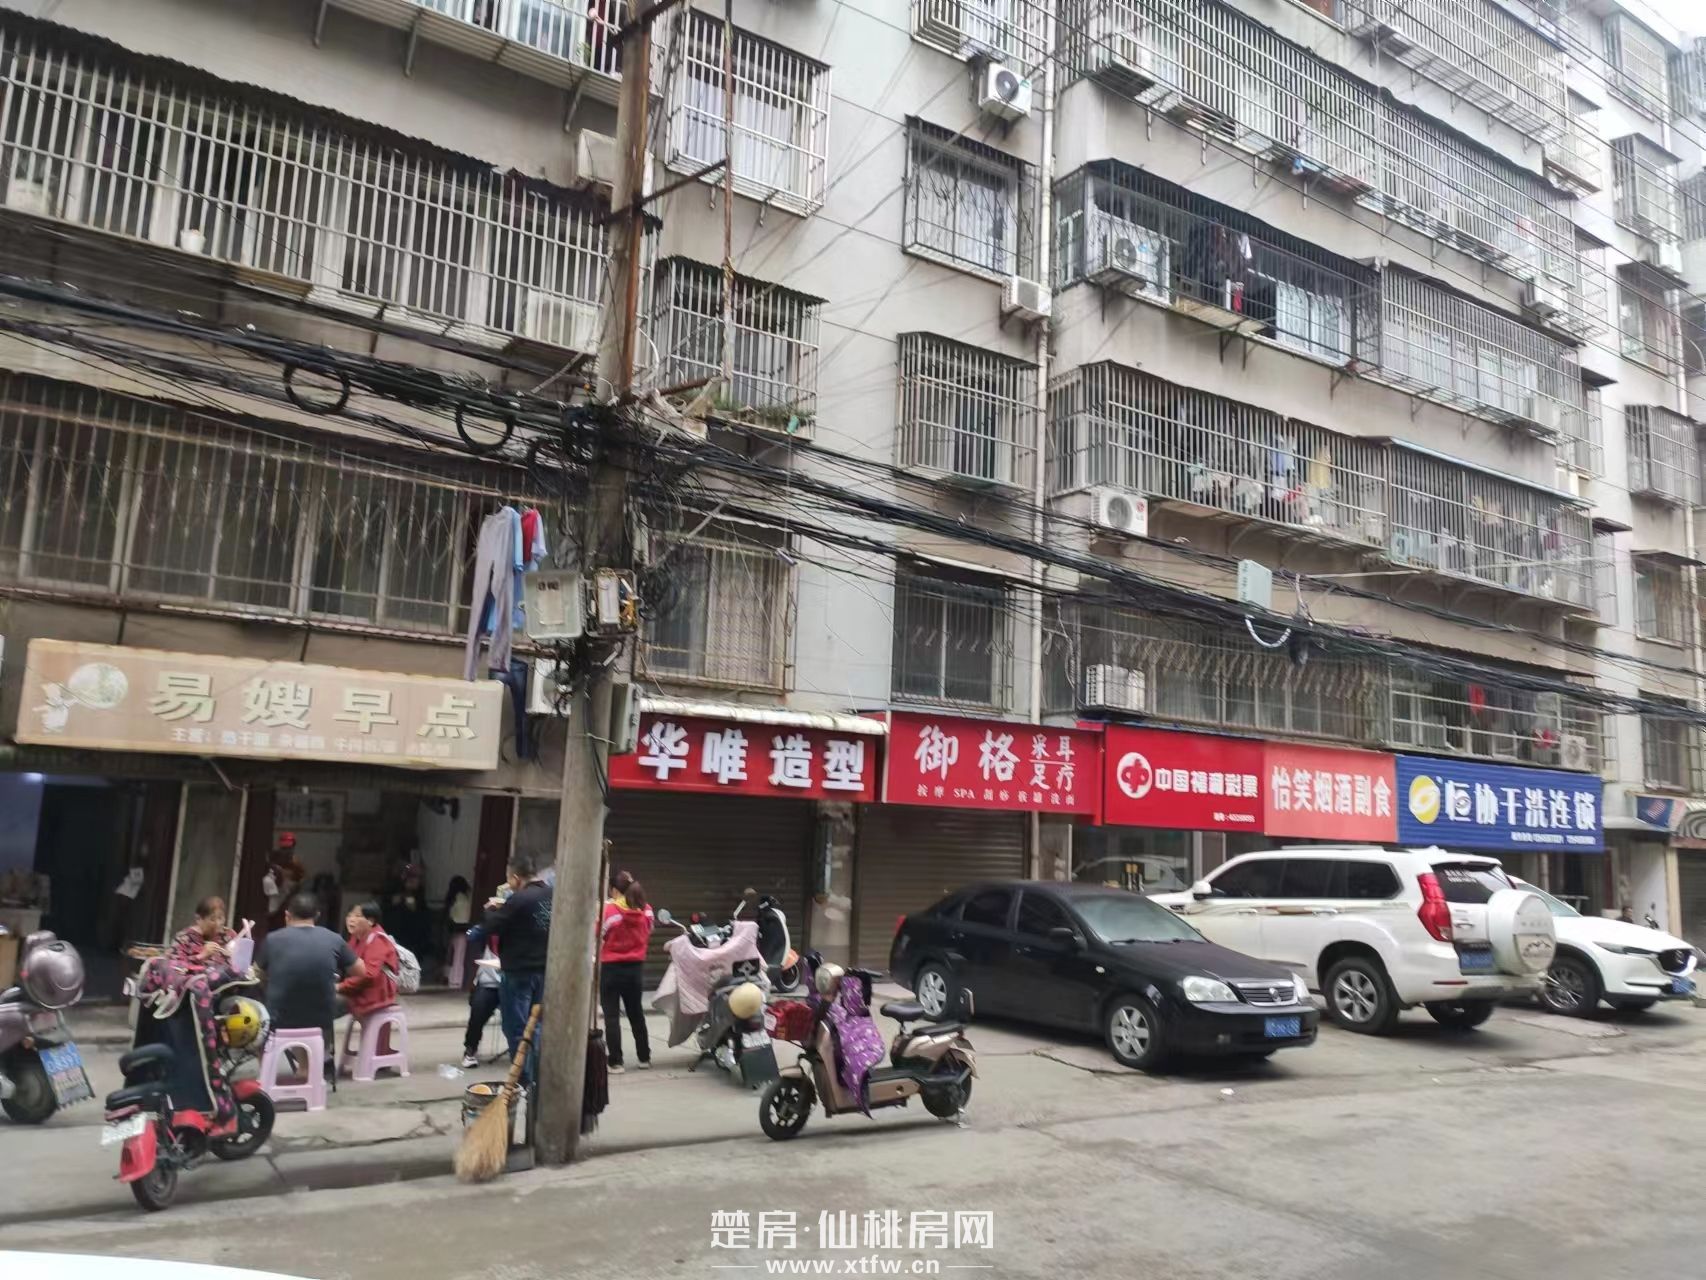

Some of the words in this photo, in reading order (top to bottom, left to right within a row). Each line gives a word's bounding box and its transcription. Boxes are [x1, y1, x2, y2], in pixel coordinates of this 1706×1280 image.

[150, 672, 478, 740] 易嫂早点
[638, 721, 865, 792] 华唯造型
[914, 724, 1021, 782] 御格
[1028, 763, 1075, 793] 足疗
[953, 787, 976, 799] SPA
[1271, 765, 1392, 817] 怡笑烟酒副食
